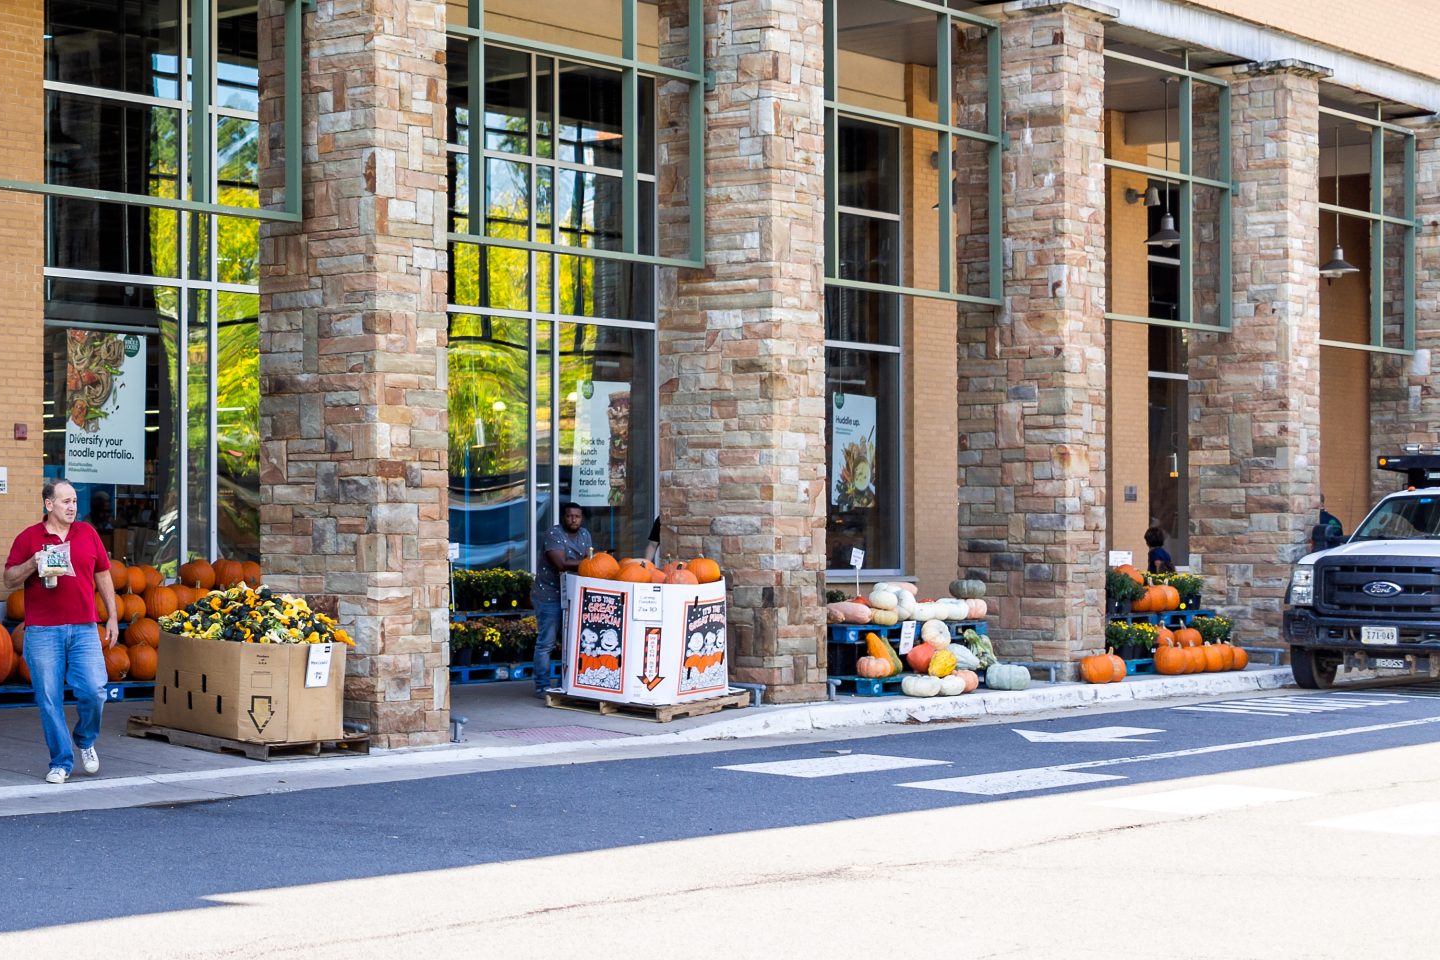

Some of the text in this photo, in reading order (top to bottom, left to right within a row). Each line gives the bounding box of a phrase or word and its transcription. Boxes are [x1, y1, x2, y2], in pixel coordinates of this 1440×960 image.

[835, 415, 852, 425] Huddle
[69, 433, 123, 448] Diversify your
[596, 438, 605, 446] the
[68, 448, 135, 460] noodle portfolio.
[580, 448, 598, 456] lunch
[580, 458, 597, 466] other
[579, 467, 605, 476] kids will
[579, 476, 607, 486] trade for.
[591, 595, 615, 604] IT'S THE
[588, 601, 617, 614] GREAT
[582, 613, 621, 628] PUMPKIN
